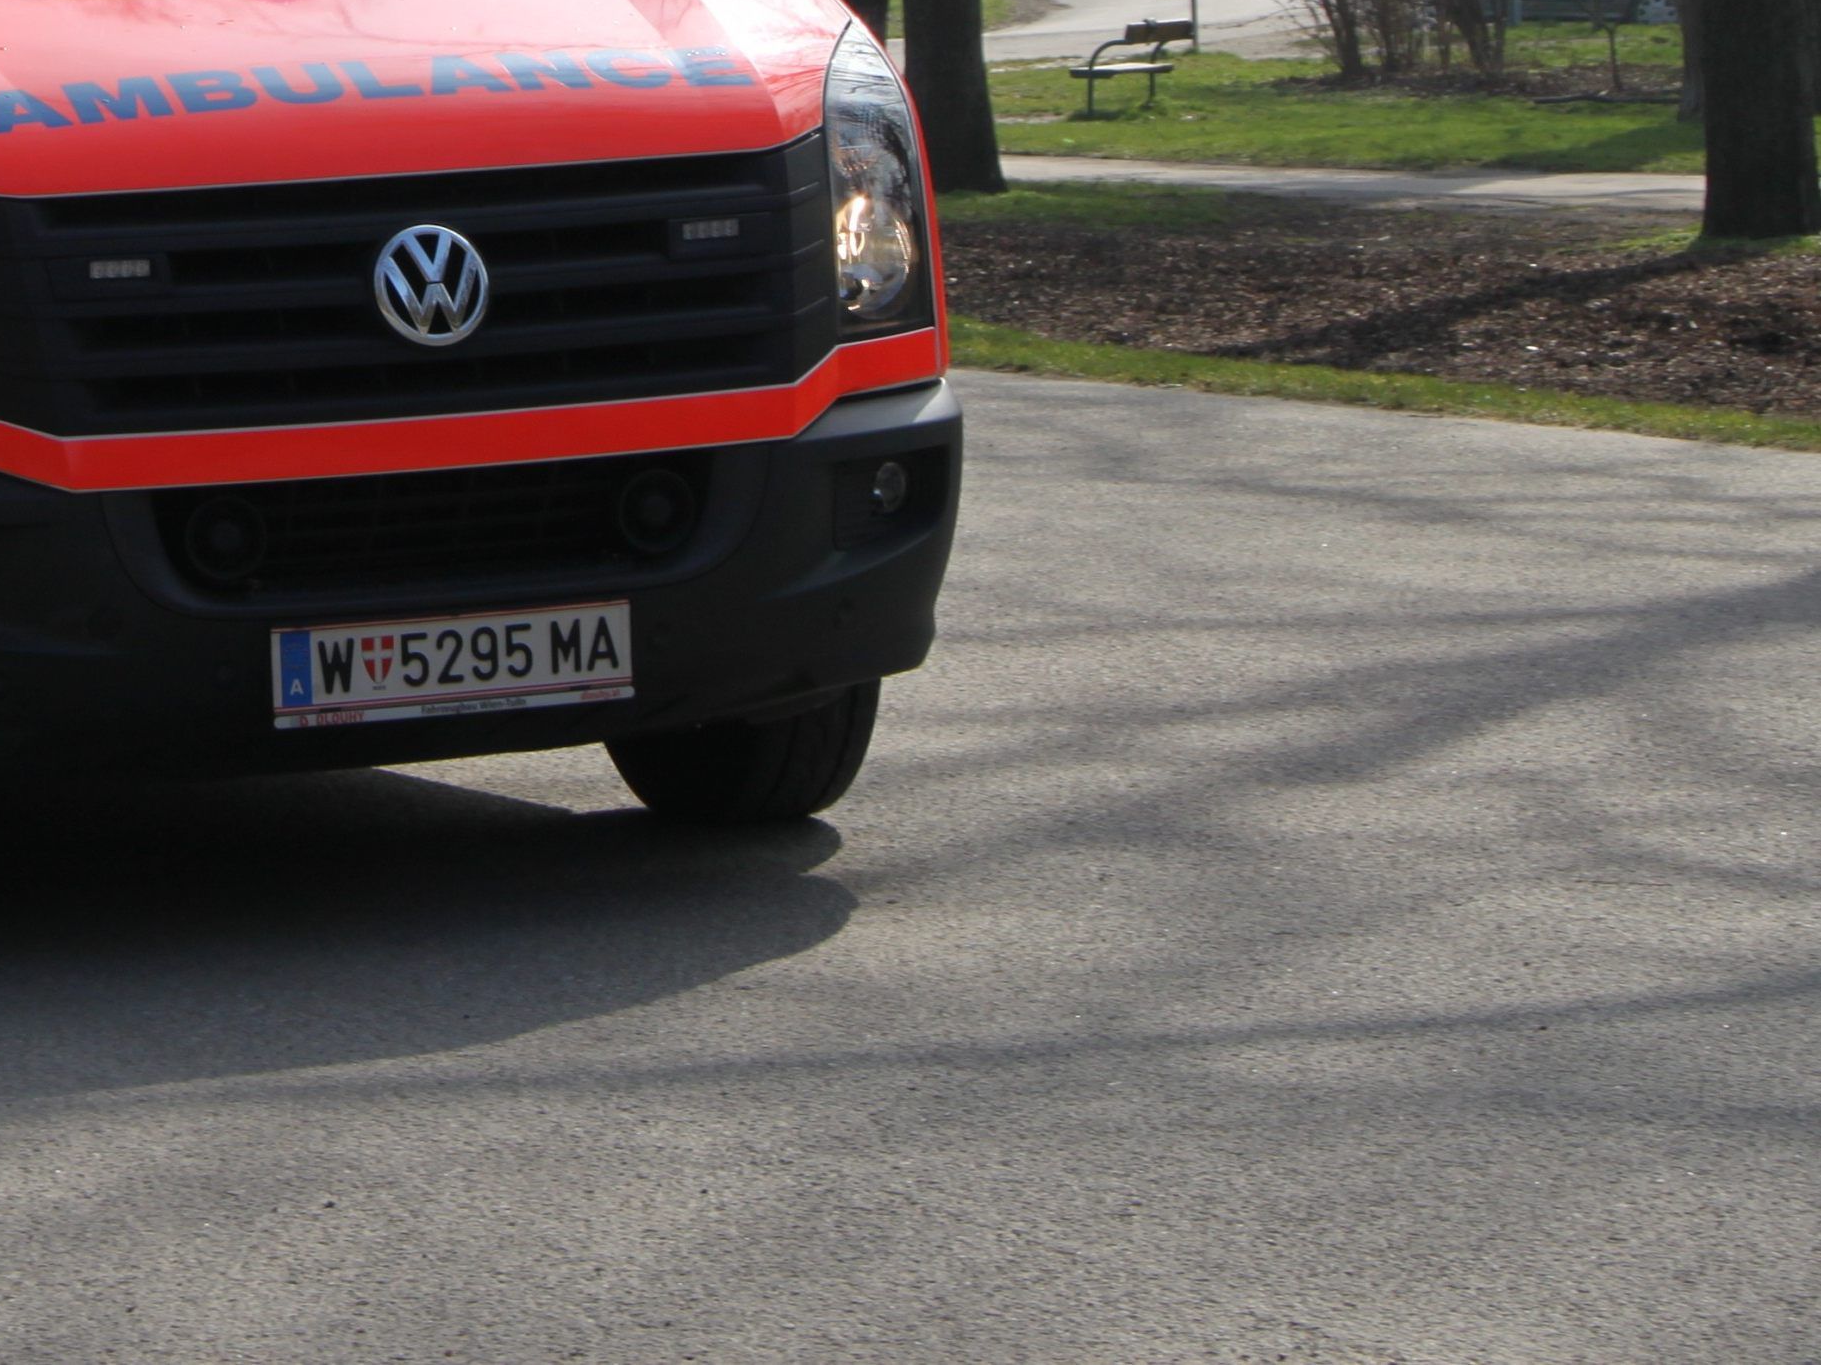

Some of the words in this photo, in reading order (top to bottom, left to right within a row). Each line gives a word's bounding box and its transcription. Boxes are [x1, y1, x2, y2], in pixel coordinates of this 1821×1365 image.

[375, 225, 487, 345] VW
[289, 679, 304, 695] A
[317, 637, 355, 695] W
[399, 623, 534, 687] 5295
[549, 616, 620, 675] MA
